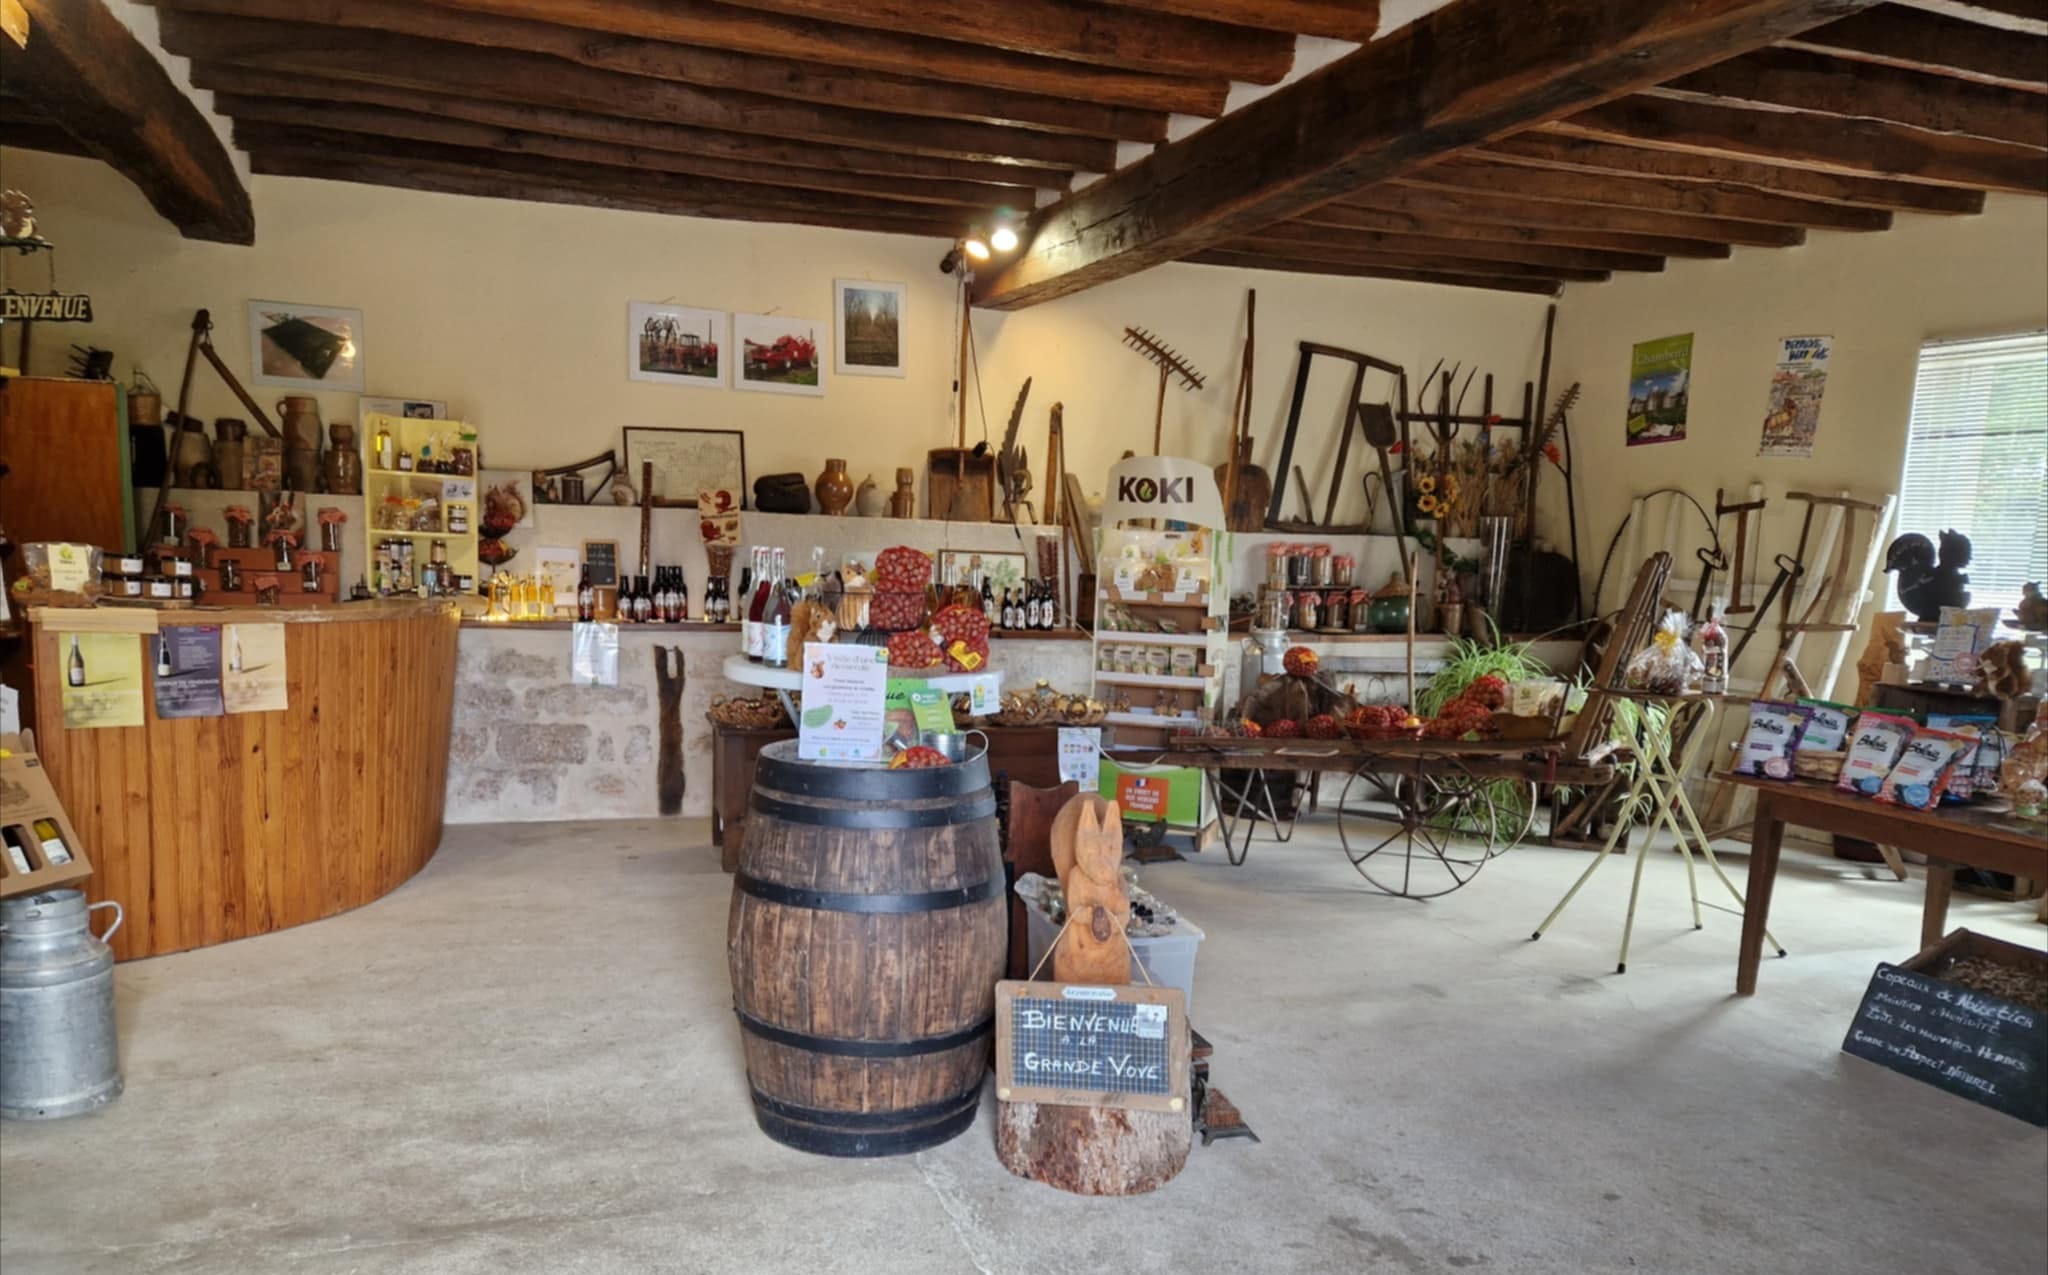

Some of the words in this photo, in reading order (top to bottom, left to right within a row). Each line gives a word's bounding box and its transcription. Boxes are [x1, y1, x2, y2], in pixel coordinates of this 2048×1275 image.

[0, 295, 89, 318] ENVENUE
[1119, 475, 1194, 504] KOKI
[1024, 1052, 1104, 1075] GRANDE
